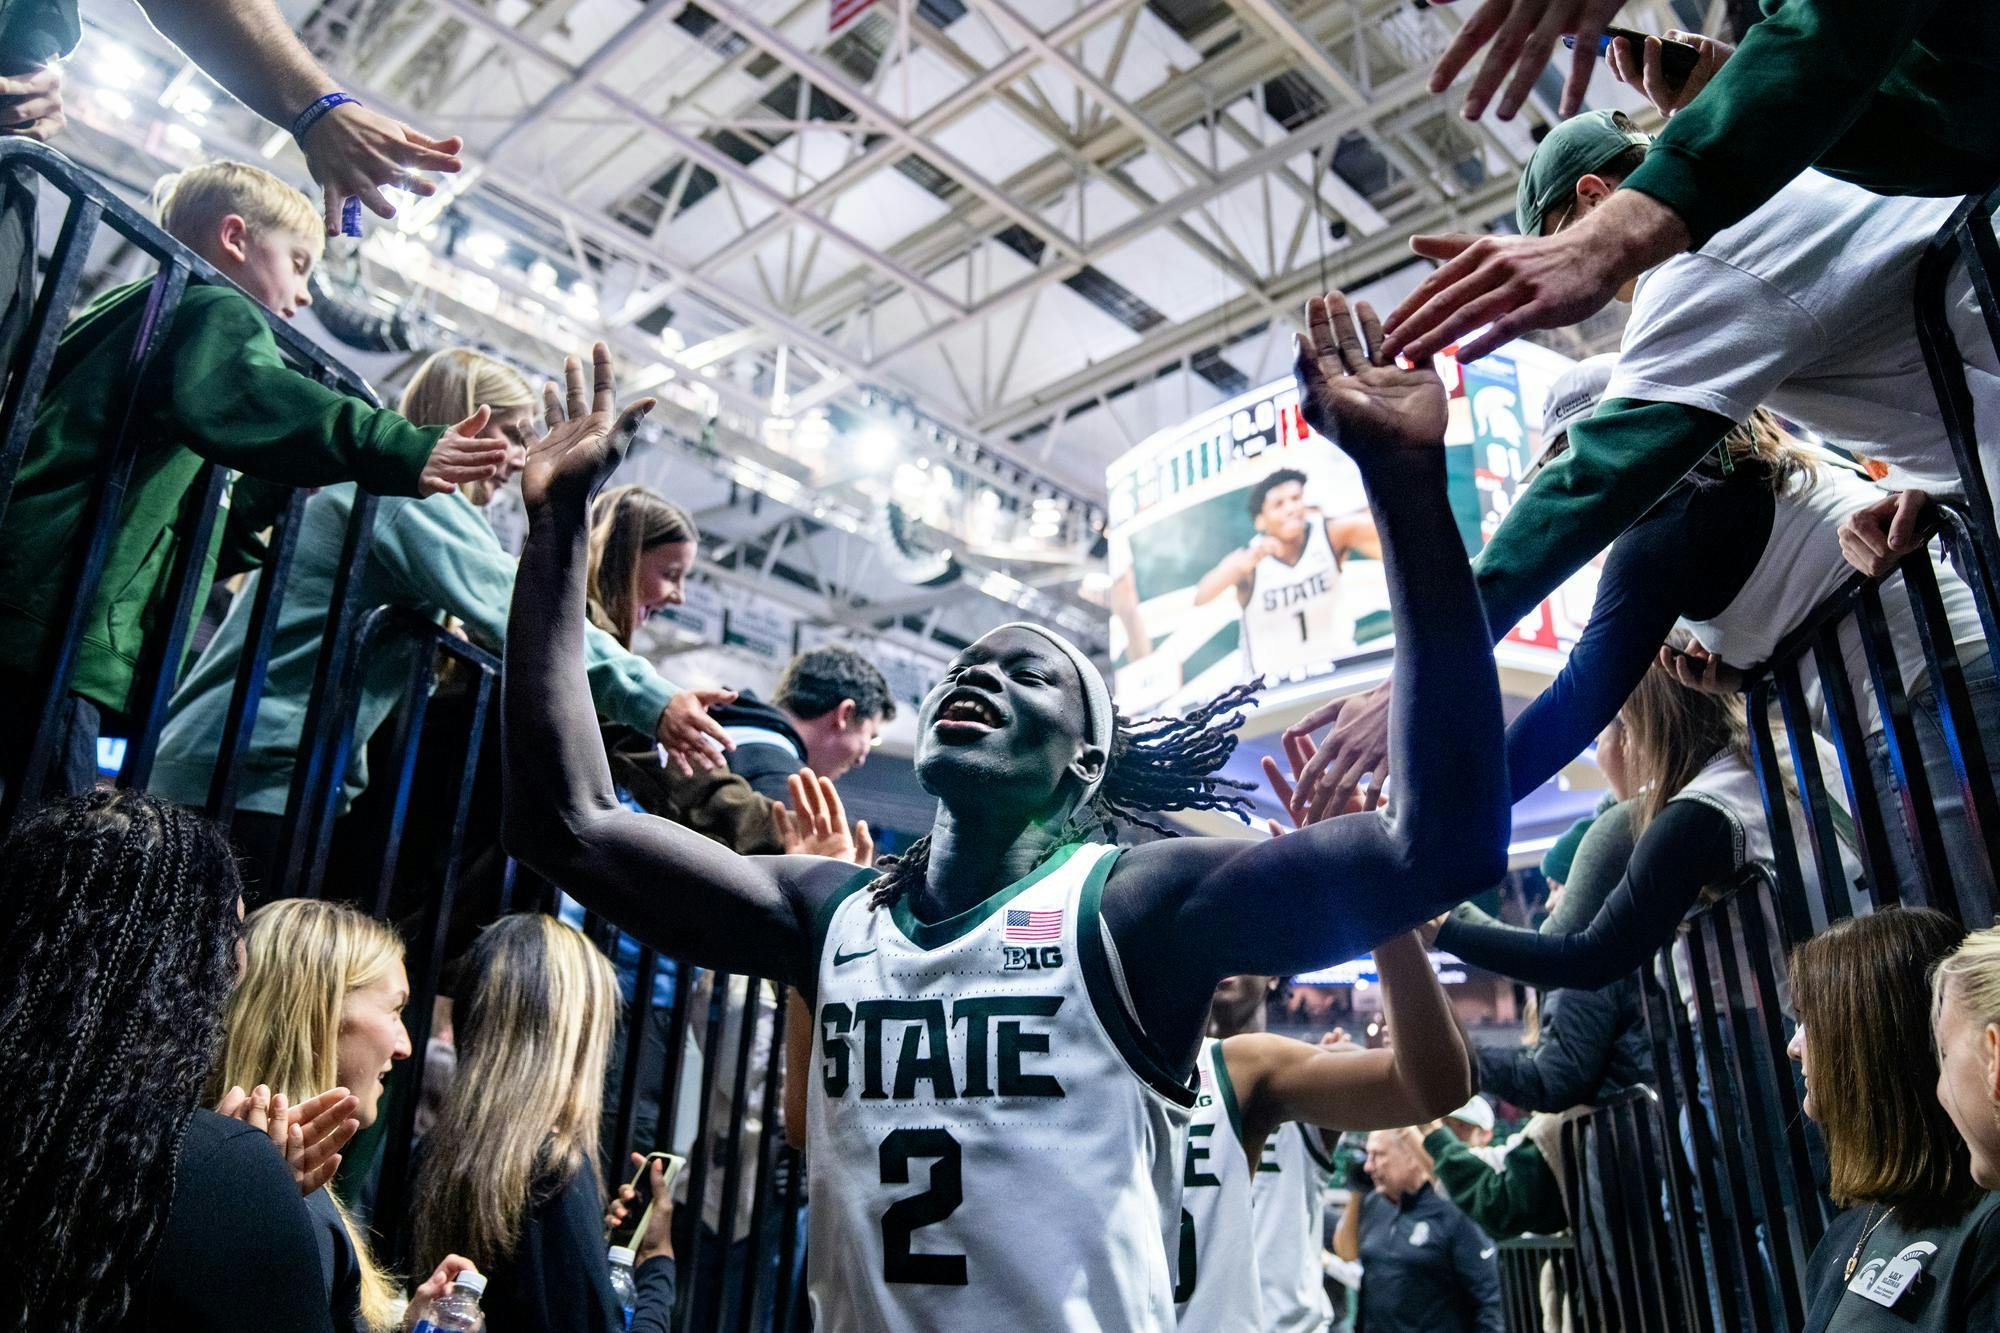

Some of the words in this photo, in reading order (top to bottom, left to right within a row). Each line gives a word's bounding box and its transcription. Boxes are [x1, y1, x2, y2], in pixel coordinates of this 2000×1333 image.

[1263, 570, 1332, 612] STATE
[1294, 610, 1308, 641] 1
[821, 996, 1066, 1099] STATE
[879, 1128, 968, 1286] 2
